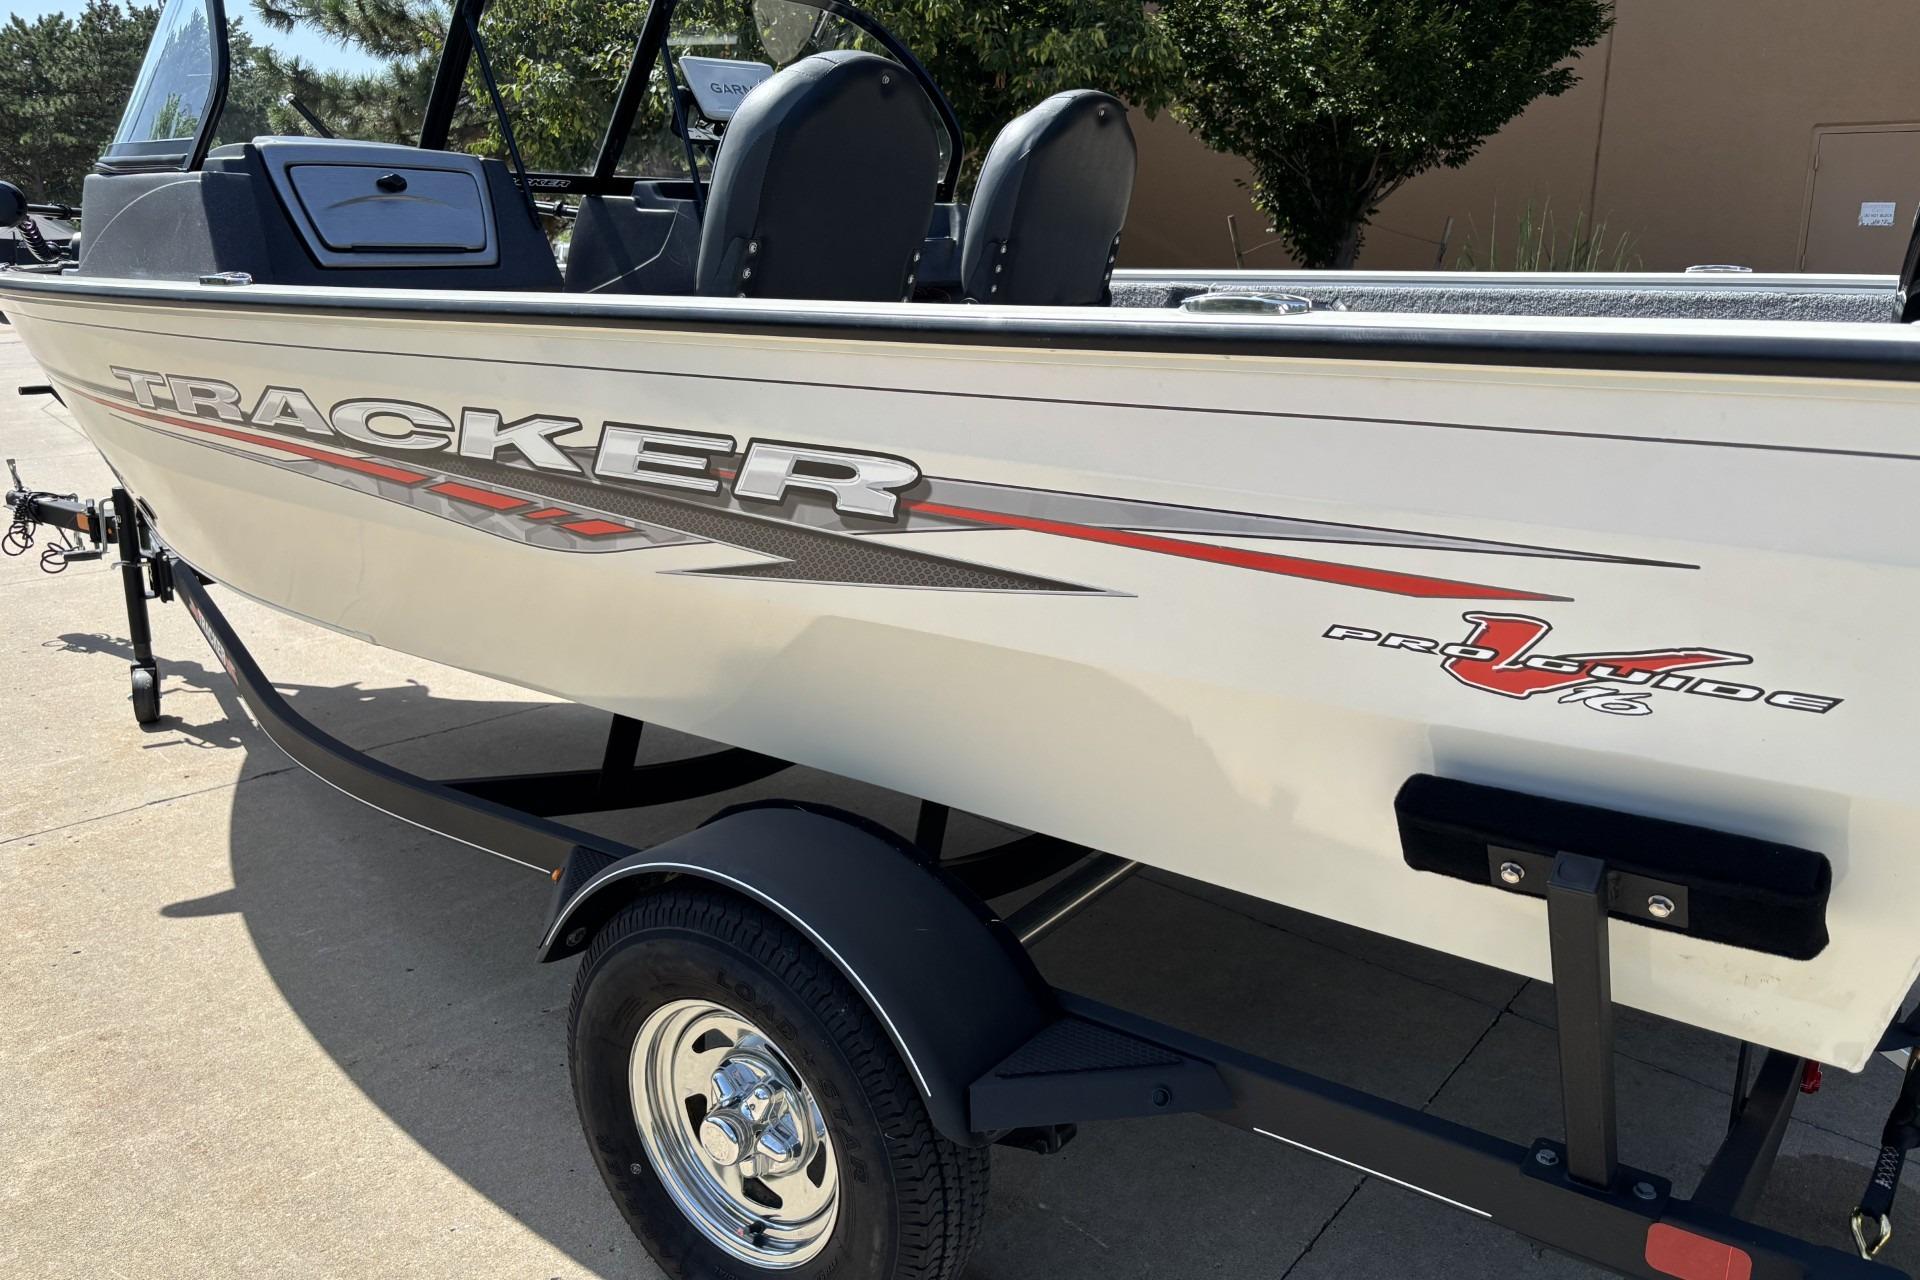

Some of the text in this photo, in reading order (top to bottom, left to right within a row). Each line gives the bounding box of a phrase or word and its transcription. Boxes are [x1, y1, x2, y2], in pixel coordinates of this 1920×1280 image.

[710, 82, 753, 95] GARM
[109, 365, 923, 520] TRACKER
[1321, 624, 1846, 715] PRO GUIDE
[1558, 686, 1653, 716] 16
[716, 967, 870, 1185] LOAD STAR
